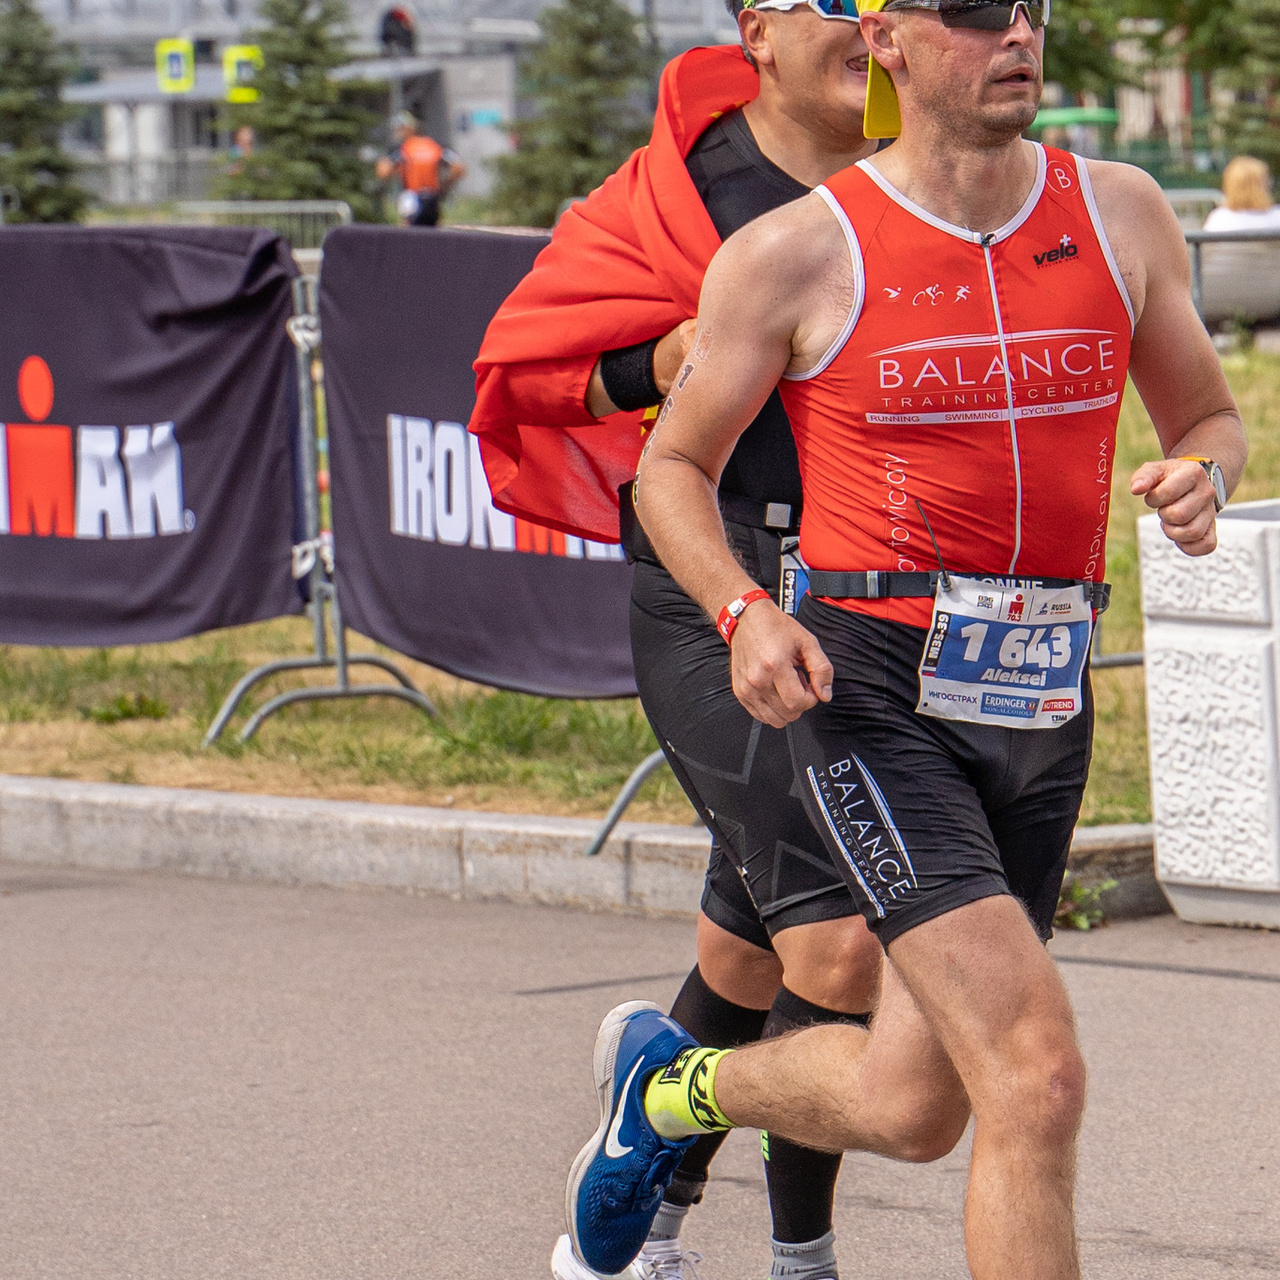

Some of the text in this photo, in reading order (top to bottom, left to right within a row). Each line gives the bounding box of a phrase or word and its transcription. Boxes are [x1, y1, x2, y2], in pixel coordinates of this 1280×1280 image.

[1054, 168, 1072, 189] B
[1033, 242, 1078, 266] velo
[878, 338, 1115, 389] BALANCE
[881, 378, 1114, 408] TRAINING CENTER
[869, 414, 920, 423] RUNNING
[944, 411, 999, 421] SWIMMING
[1020, 405, 1065, 416] CYCLING
[0, 420, 186, 539] MAN
[386, 413, 627, 562] IRON
[1083, 436, 1109, 582] way to victor
[928, 614, 950, 659] M35-39
[960, 622, 1072, 669] 1 643
[980, 667, 1047, 687] Aleksei
[928, 690, 978, 705] ИНГОССТРАХ
[984, 695, 1027, 709] ERDINGER
[1043, 700, 1074, 710] NUTREND
[817, 770, 890, 906] TRAINING CENTER
[829, 758, 912, 900] BALANCE
